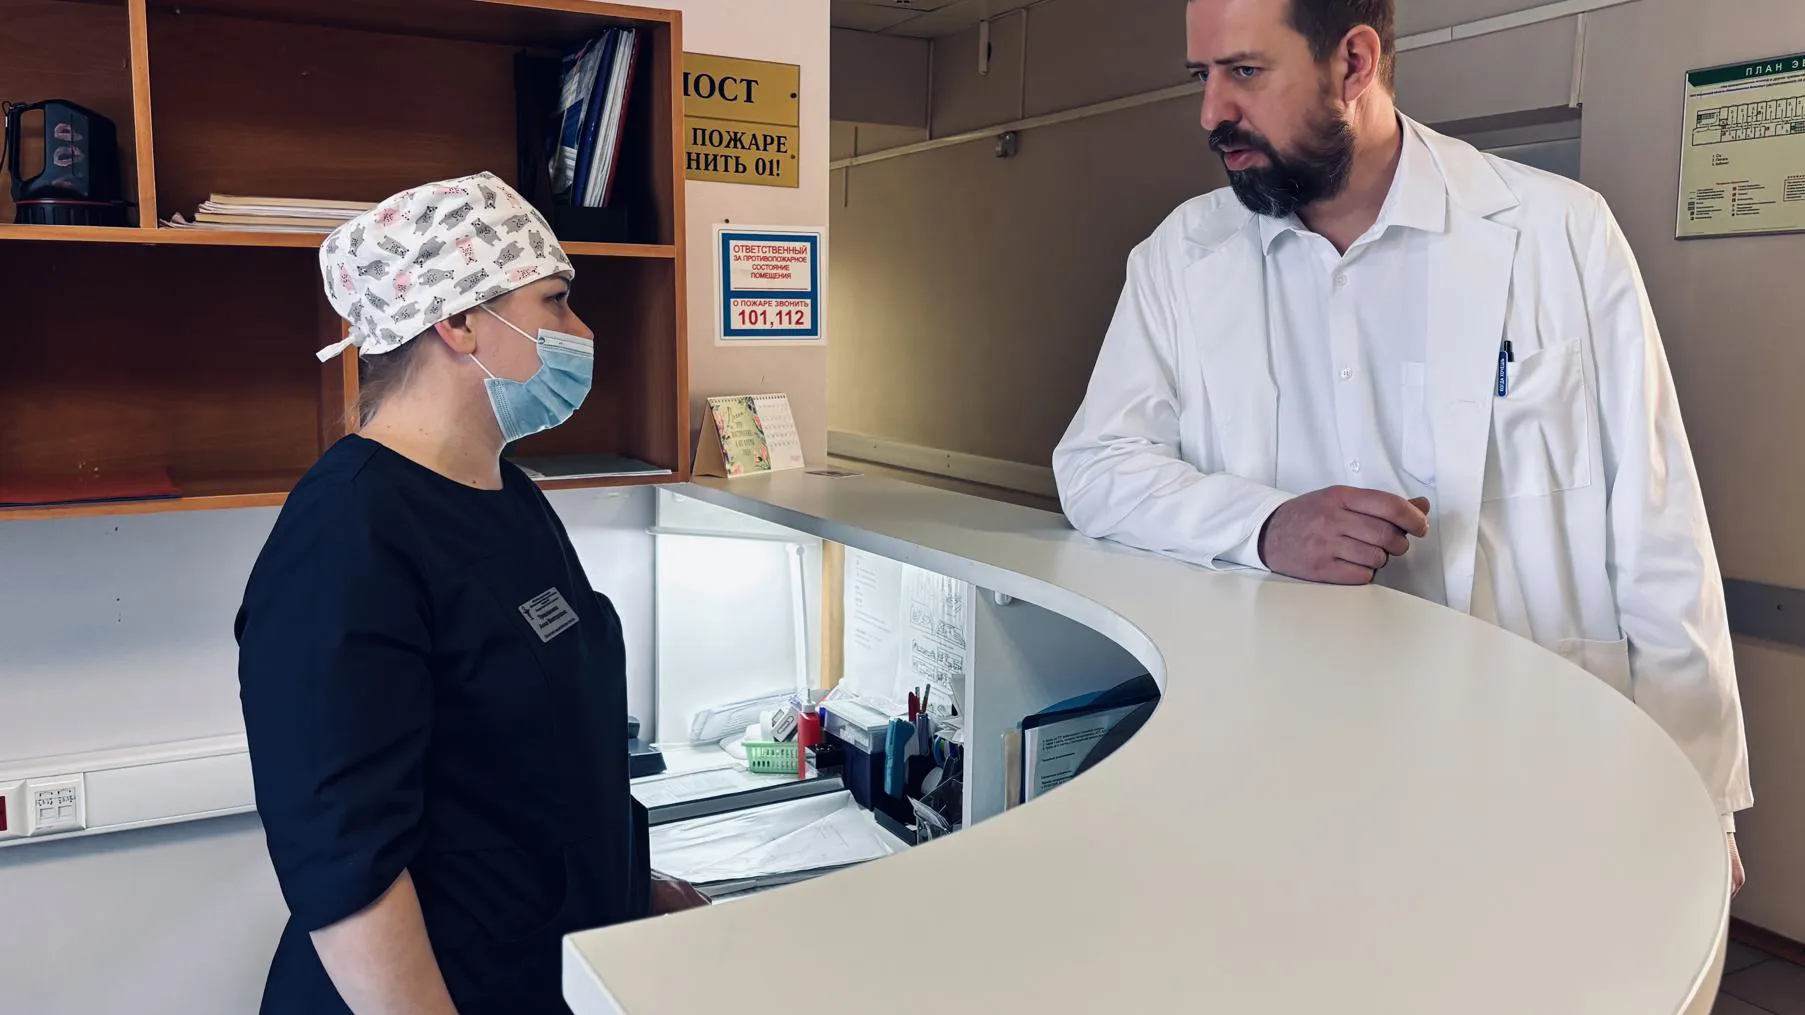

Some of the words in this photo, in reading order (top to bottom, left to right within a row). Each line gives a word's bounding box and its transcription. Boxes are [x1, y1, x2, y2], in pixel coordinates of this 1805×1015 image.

[1745, 62, 1783, 76] ПЛАН
[692, 127, 788, 153] ПОЖАРЕ
[754, 157, 781, 177] 01!
[733, 244, 807, 255] ОТВЕТСТВЕННЫЙ
[743, 255, 807, 263] ПРОТИВОПОЖАРНОЕ
[751, 272, 791, 280] ПОМЕЩЕНИЯ
[738, 310, 804, 328] 101,112
